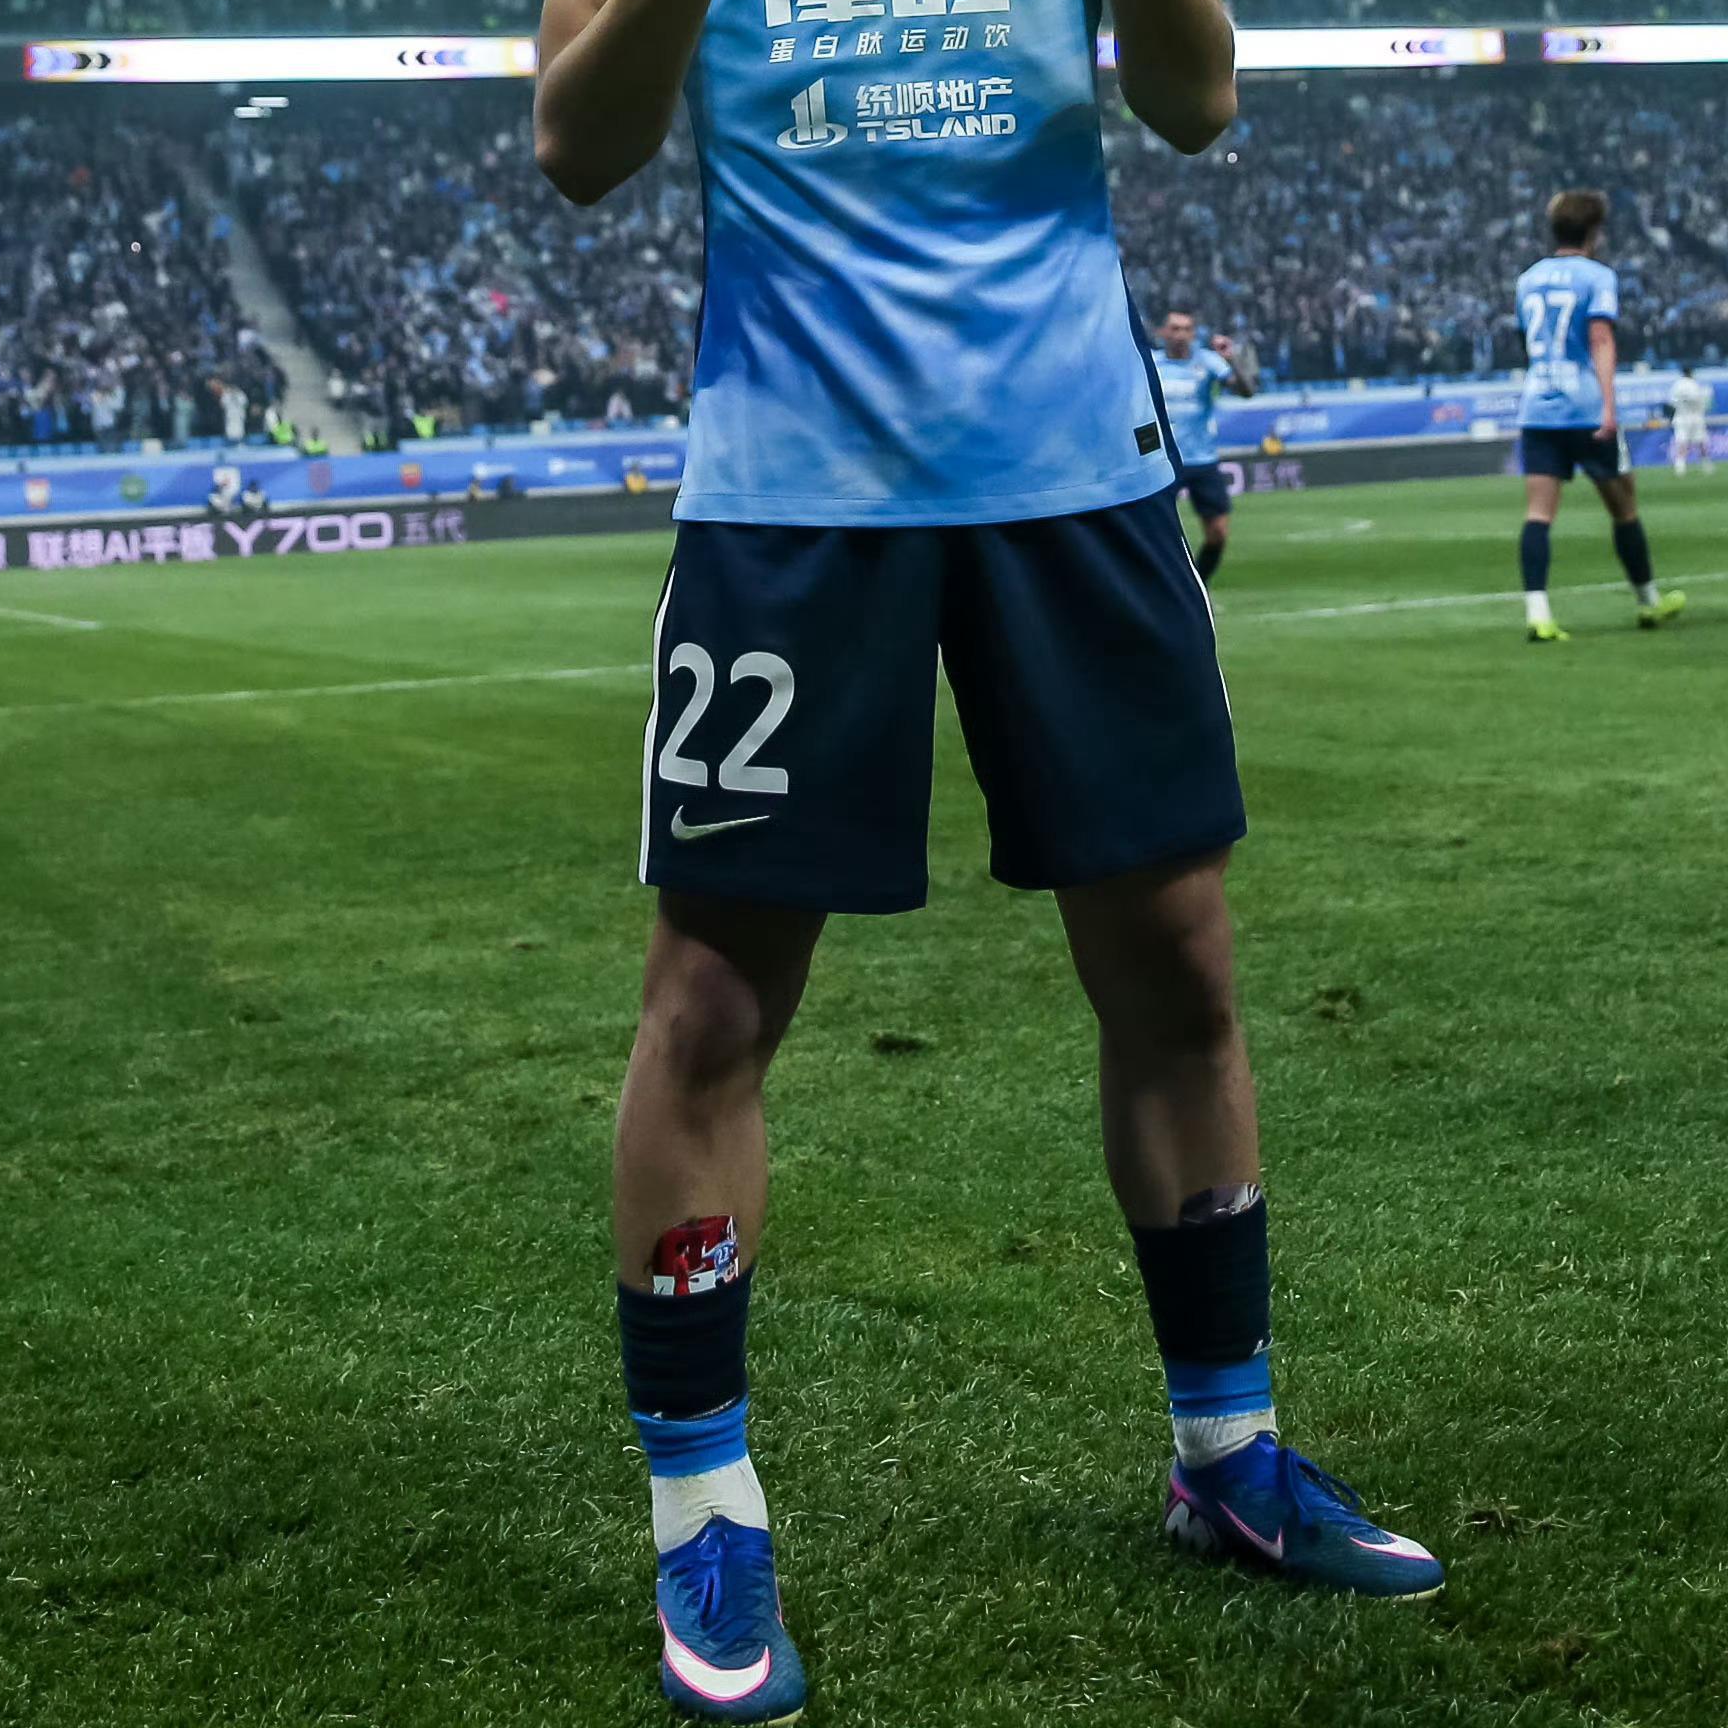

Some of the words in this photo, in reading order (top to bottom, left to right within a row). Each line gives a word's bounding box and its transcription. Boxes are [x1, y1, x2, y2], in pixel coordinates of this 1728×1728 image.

[768, 23, 1012, 64] 蛋白肽运动饮
[855, 76, 1014, 118] 统顺地产
[856, 113, 1017, 143] TSLAND
[1522, 289, 1577, 360] 27
[223, 511, 395, 557] Y700
[659, 642, 796, 795] 22
